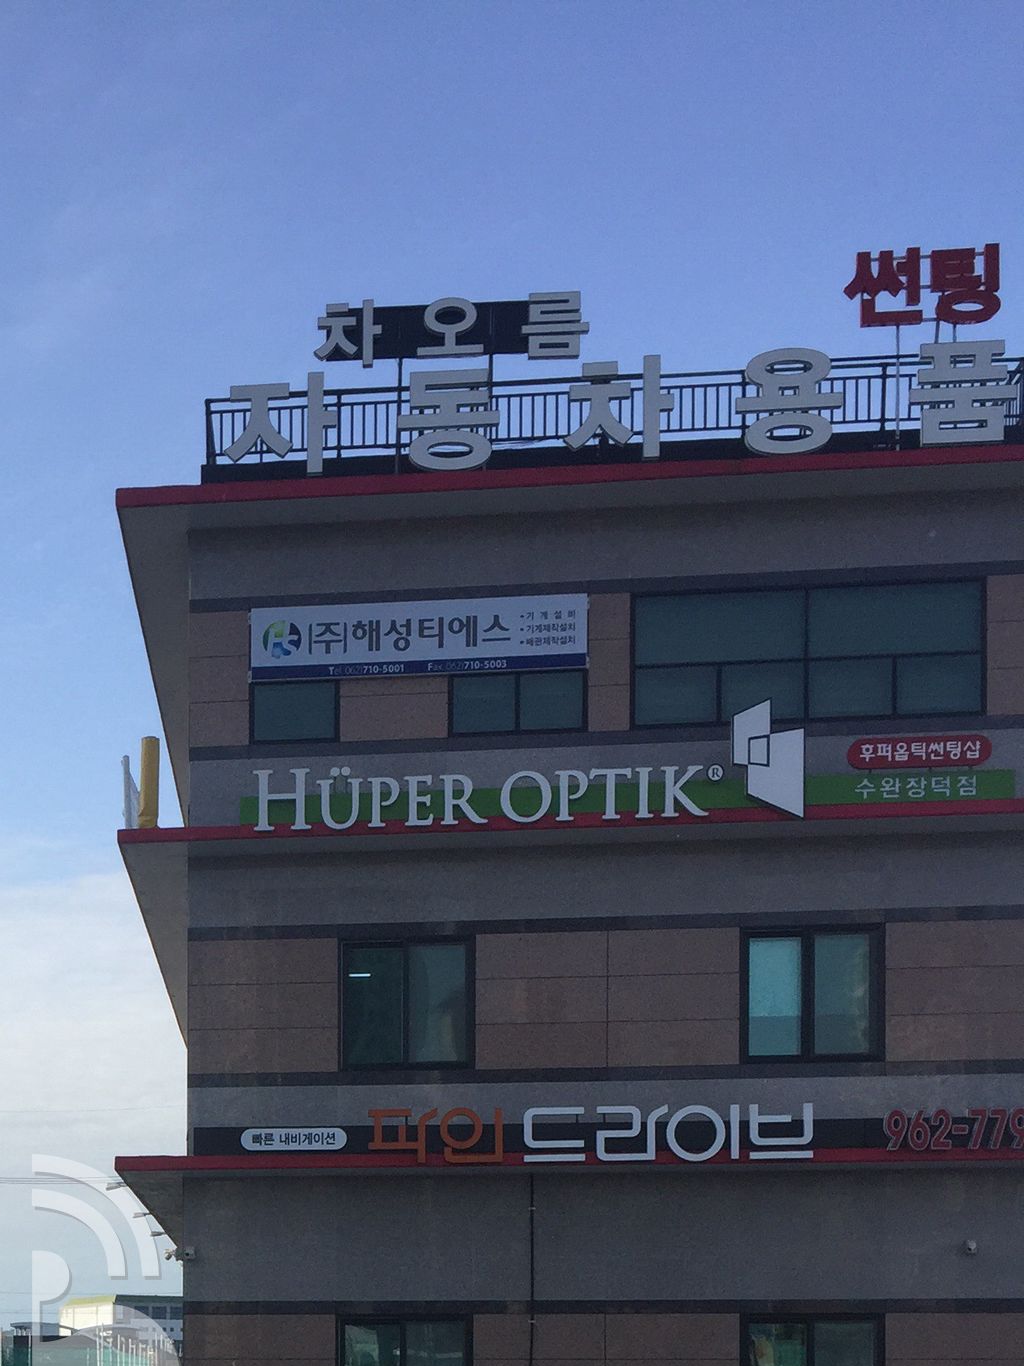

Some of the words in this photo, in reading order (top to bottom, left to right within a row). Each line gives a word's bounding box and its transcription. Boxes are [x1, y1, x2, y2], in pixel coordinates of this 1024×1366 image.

[843, 243, 1002, 328] 썬팅
[313, 290, 590, 368] 차오름
[224, 339, 1019, 477] 자동차용품
[252, 766, 488, 831] HÜPER
[855, 775, 977, 799] 수완장덕점
[252, 1132, 275, 1146] 빠른
[279, 1130, 337, 1146] 내비게이션
